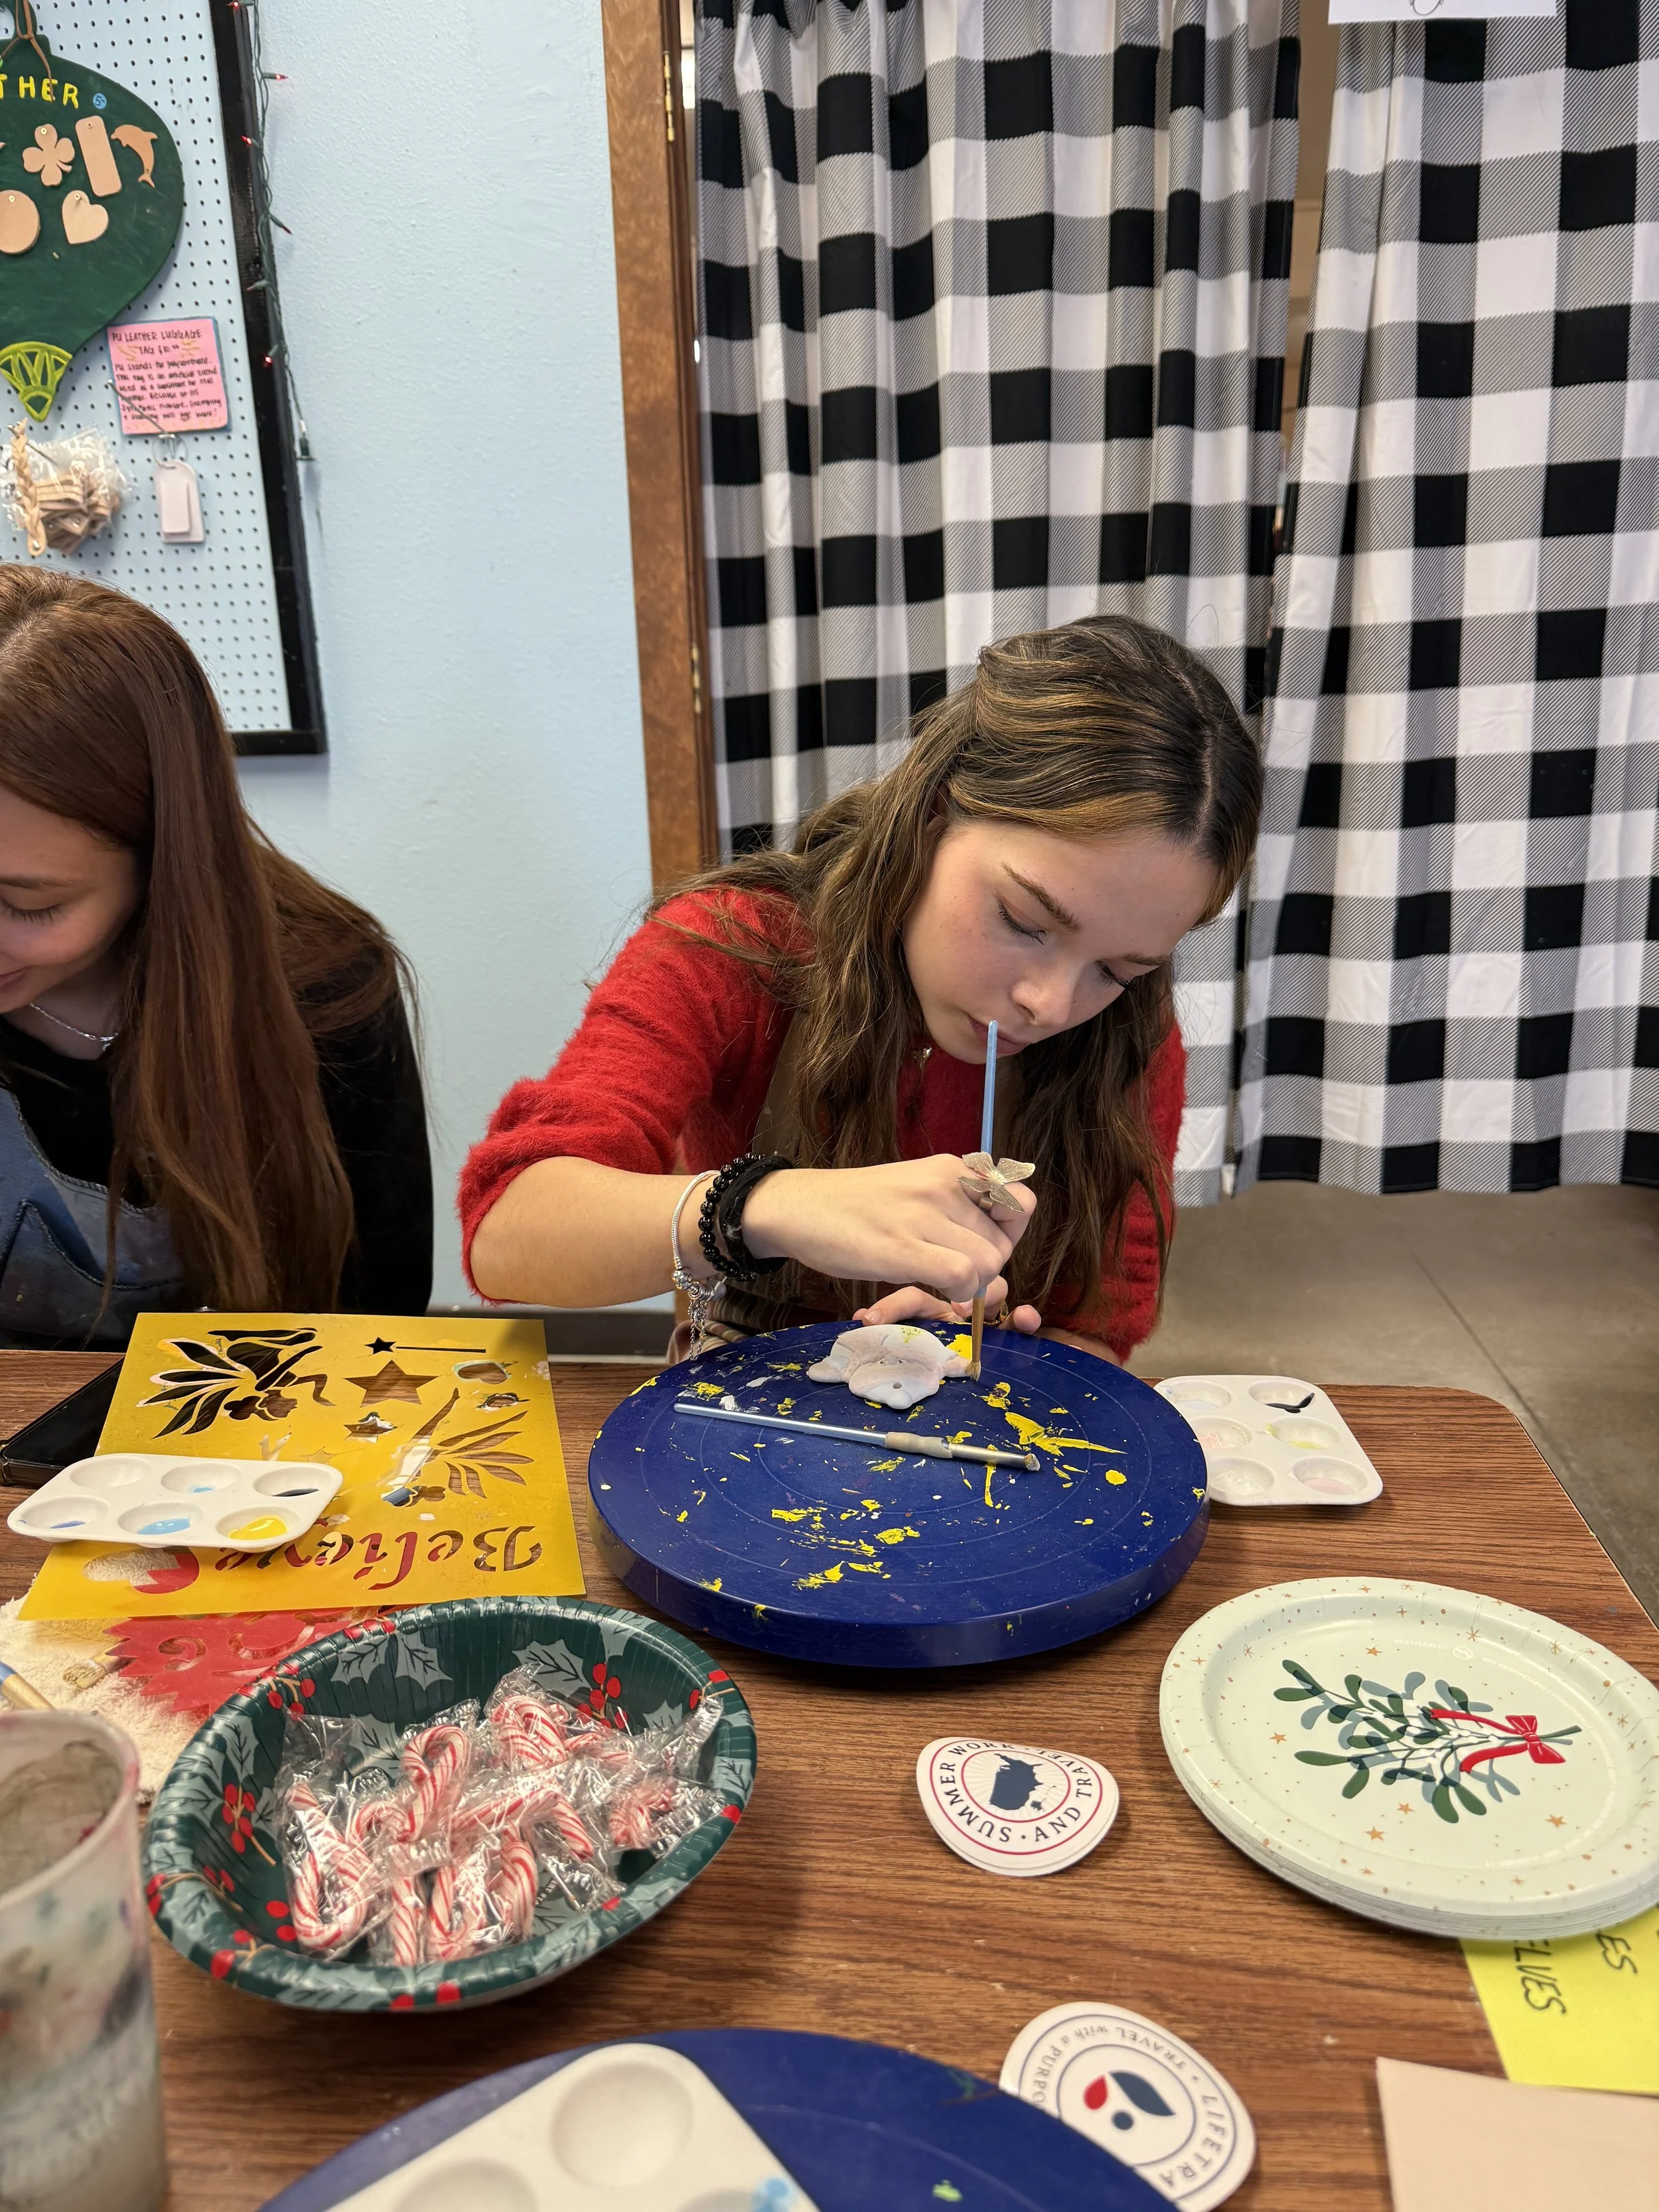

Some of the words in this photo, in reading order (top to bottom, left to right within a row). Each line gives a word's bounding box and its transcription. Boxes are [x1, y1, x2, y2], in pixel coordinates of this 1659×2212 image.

[111, 332, 122, 342] PU
[125, 331, 157, 342] LEATHER
[161, 329, 202, 340] LUGGAGE
[139, 346, 154, 354] TAG
[214, 1526, 543, 1590] Believe
[948, 1741, 1015, 1756] WORK
[1035, 1748, 1093, 1799] TRAVEL
[940, 1761, 1011, 1842] SUMMER
[1035, 1806, 1082, 1842] AND
[1060, 2035, 1070, 2045] a
[1074, 2025, 1109, 2041] with
[1116, 2026, 1186, 2069] TRAVEL
